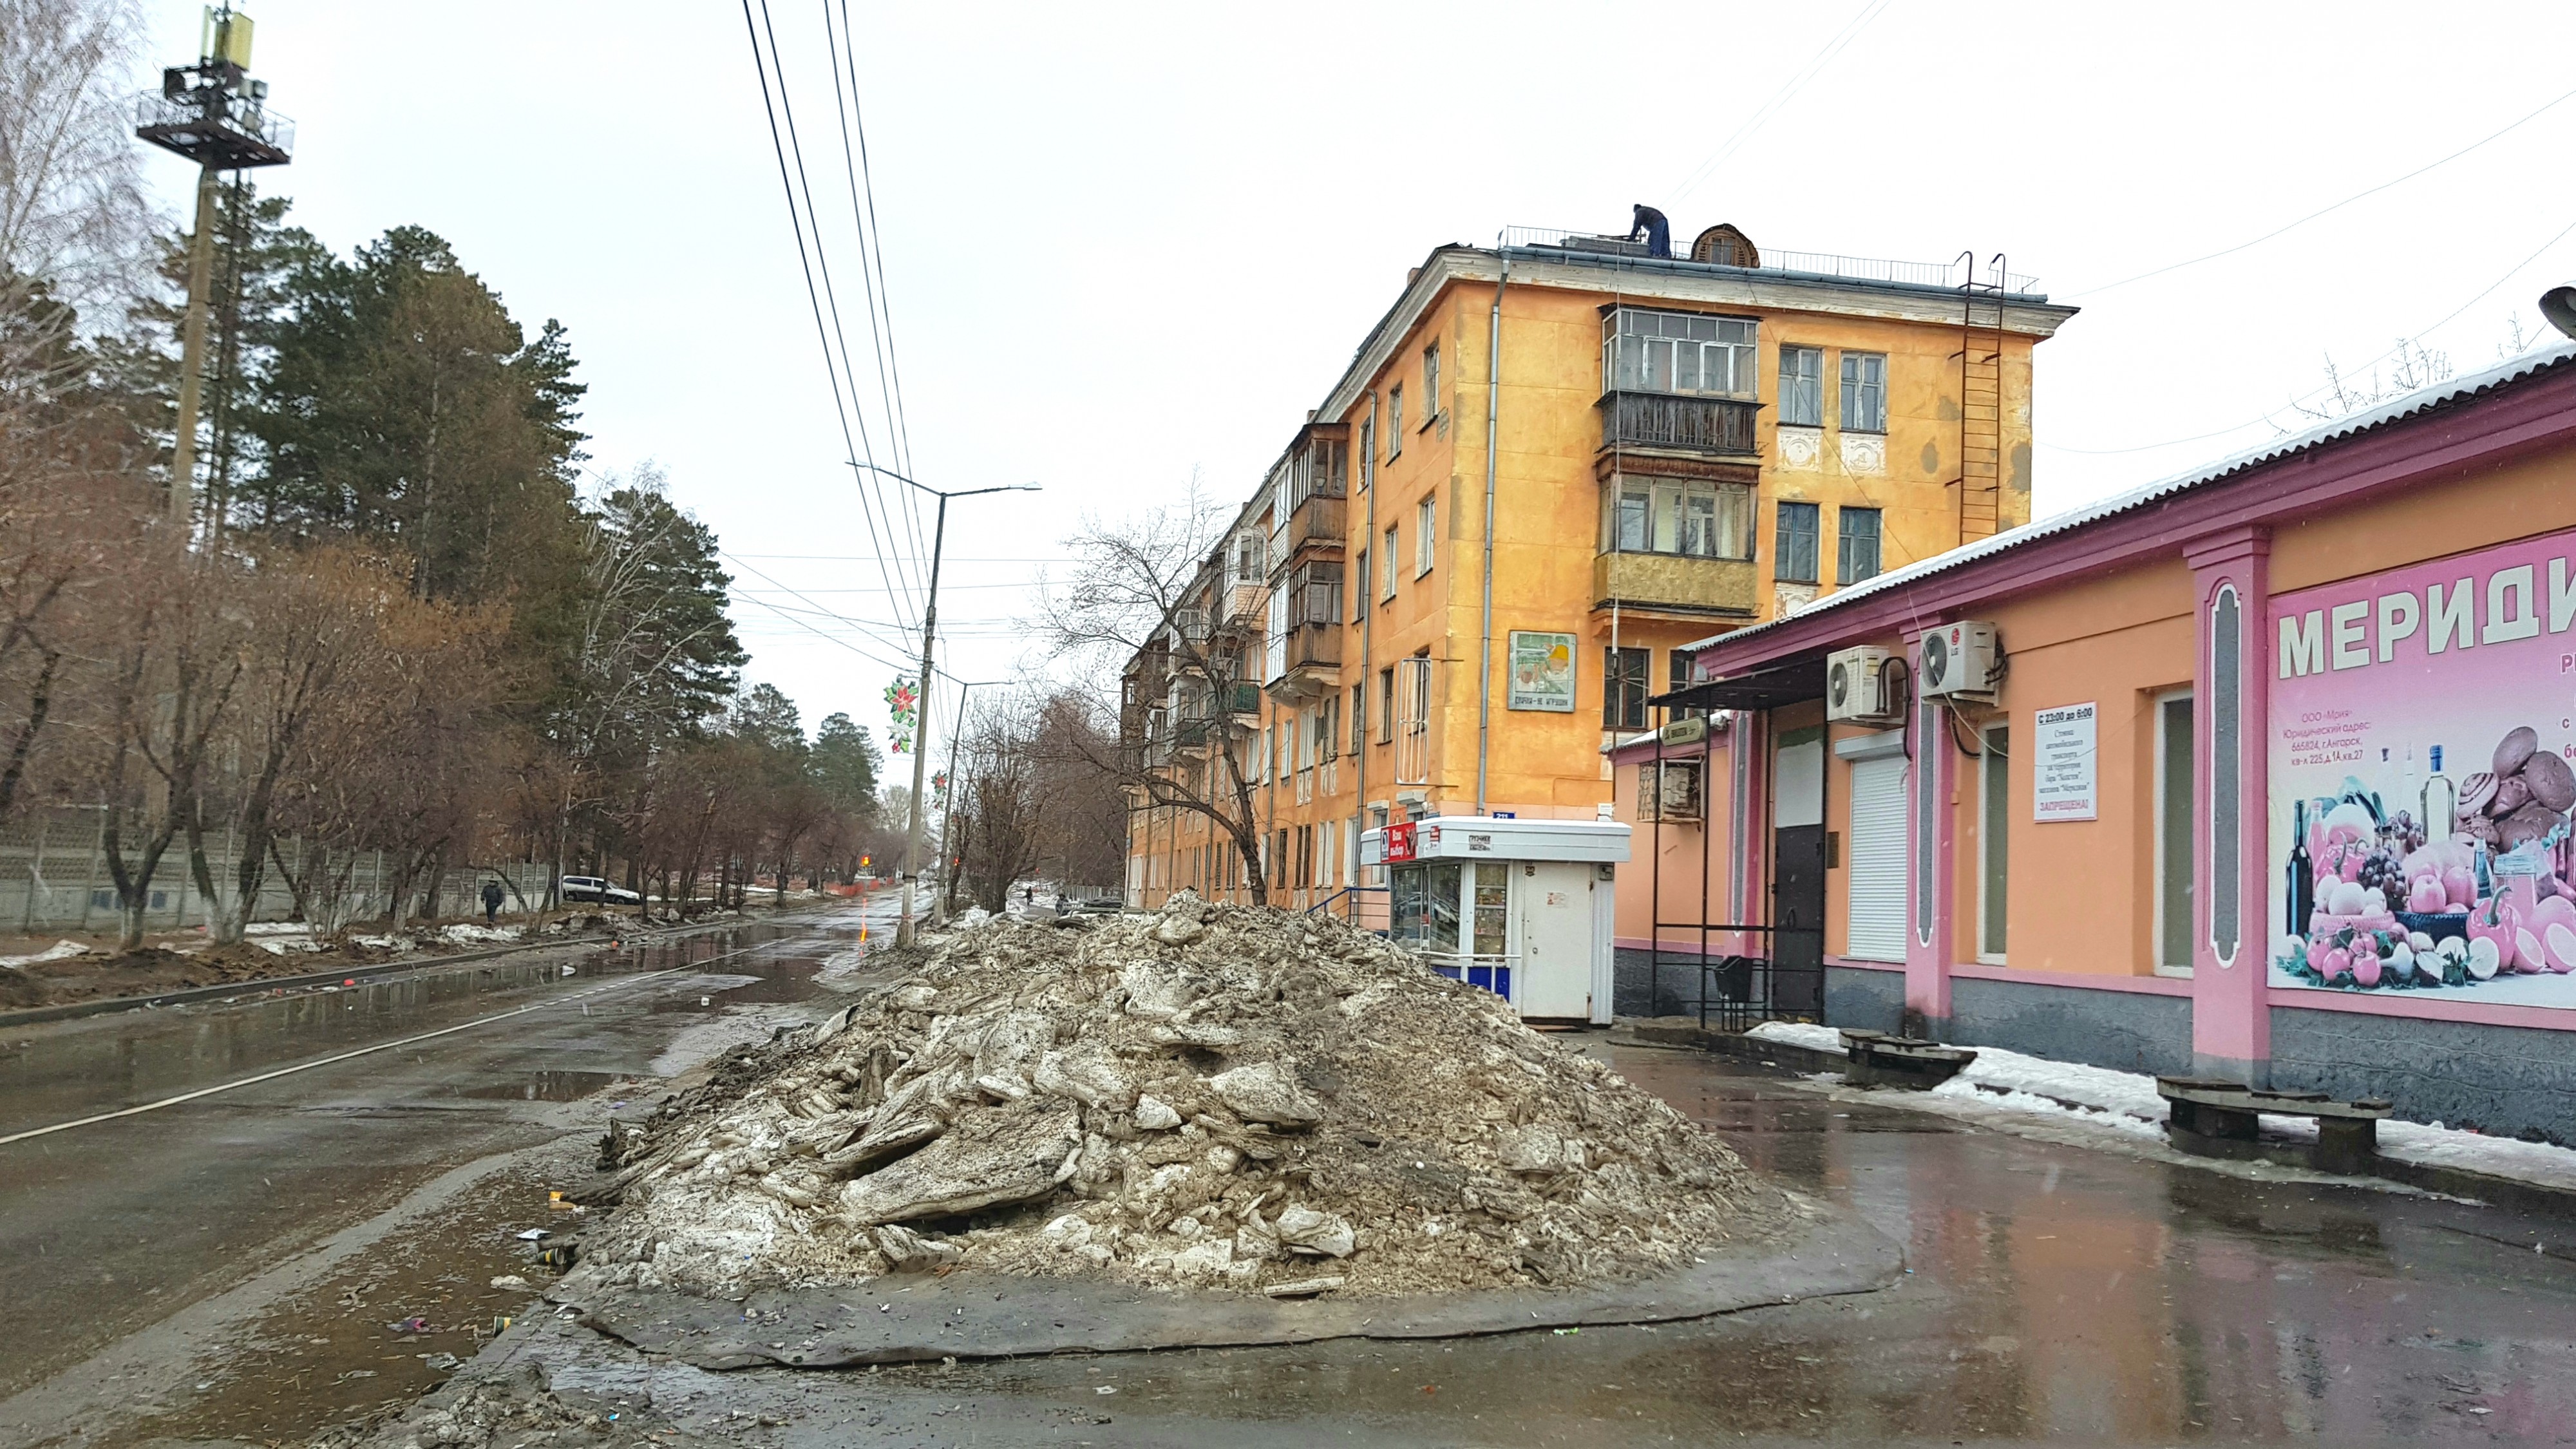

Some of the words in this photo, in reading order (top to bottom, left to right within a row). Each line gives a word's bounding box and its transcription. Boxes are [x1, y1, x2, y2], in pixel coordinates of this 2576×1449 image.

[2278, 556, 2576, 679] МЕРИДИ
[1951, 647, 1958, 656] LG
[2561, 654, 2576, 674] Р
[2045, 712, 2064, 723] 23:00
[2066, 712, 2075, 721] до
[2076, 707, 2092, 718] 6:00
[2302, 712, 2322, 723] ООО
[2283, 724, 2342, 740] Юридический
